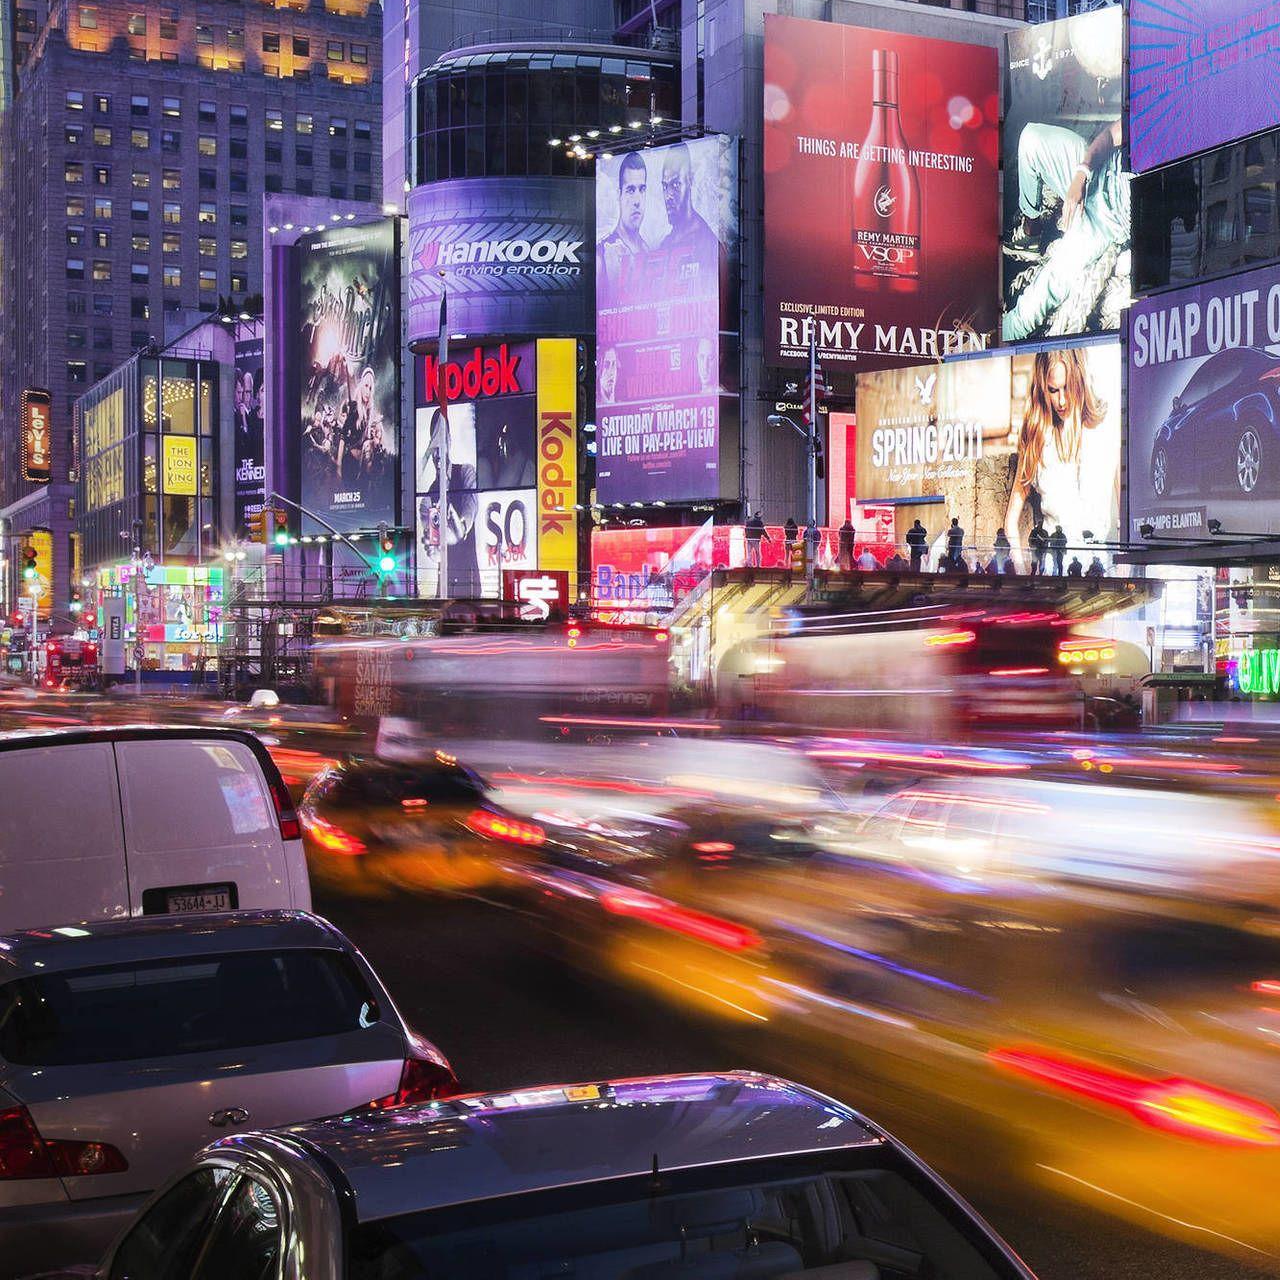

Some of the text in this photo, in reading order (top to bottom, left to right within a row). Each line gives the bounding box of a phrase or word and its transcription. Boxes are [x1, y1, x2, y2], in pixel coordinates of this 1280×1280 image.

[1009, 58, 1030, 70] SINCE
[797, 136, 972, 173] THINGS ARE GETTING INTERESTING
[882, 234, 915, 246] MARTIN
[857, 244, 914, 264] VSOP
[456, 264, 581, 277] driving emotion
[780, 302, 865, 318] EXCLUSIVE LIMITED EDITION
[1133, 302, 1201, 368] SNAP
[1206, 289, 1259, 354] OUT
[873, 323, 988, 357] MARTIN
[425, 343, 521, 402] Kodak
[601, 406, 715, 438] SATURDAY MARCH 19
[171, 446, 190, 457] THE
[601, 428, 715, 457] LIVE ON PAY-PER-VIEW
[872, 420, 983, 468] SPRING 2011
[167, 457, 192, 471] LION
[241, 458, 254, 470] THE
[541, 411, 572, 536] Kodak
[167, 472, 193, 487] KING
[333, 491, 352, 505] MARCH
[486, 498, 527, 551] SO
[1172, 510, 1203, 529] ELANTRA
[355, 664, 392, 684] SANTA
[575, 687, 653, 706] JCPenney
